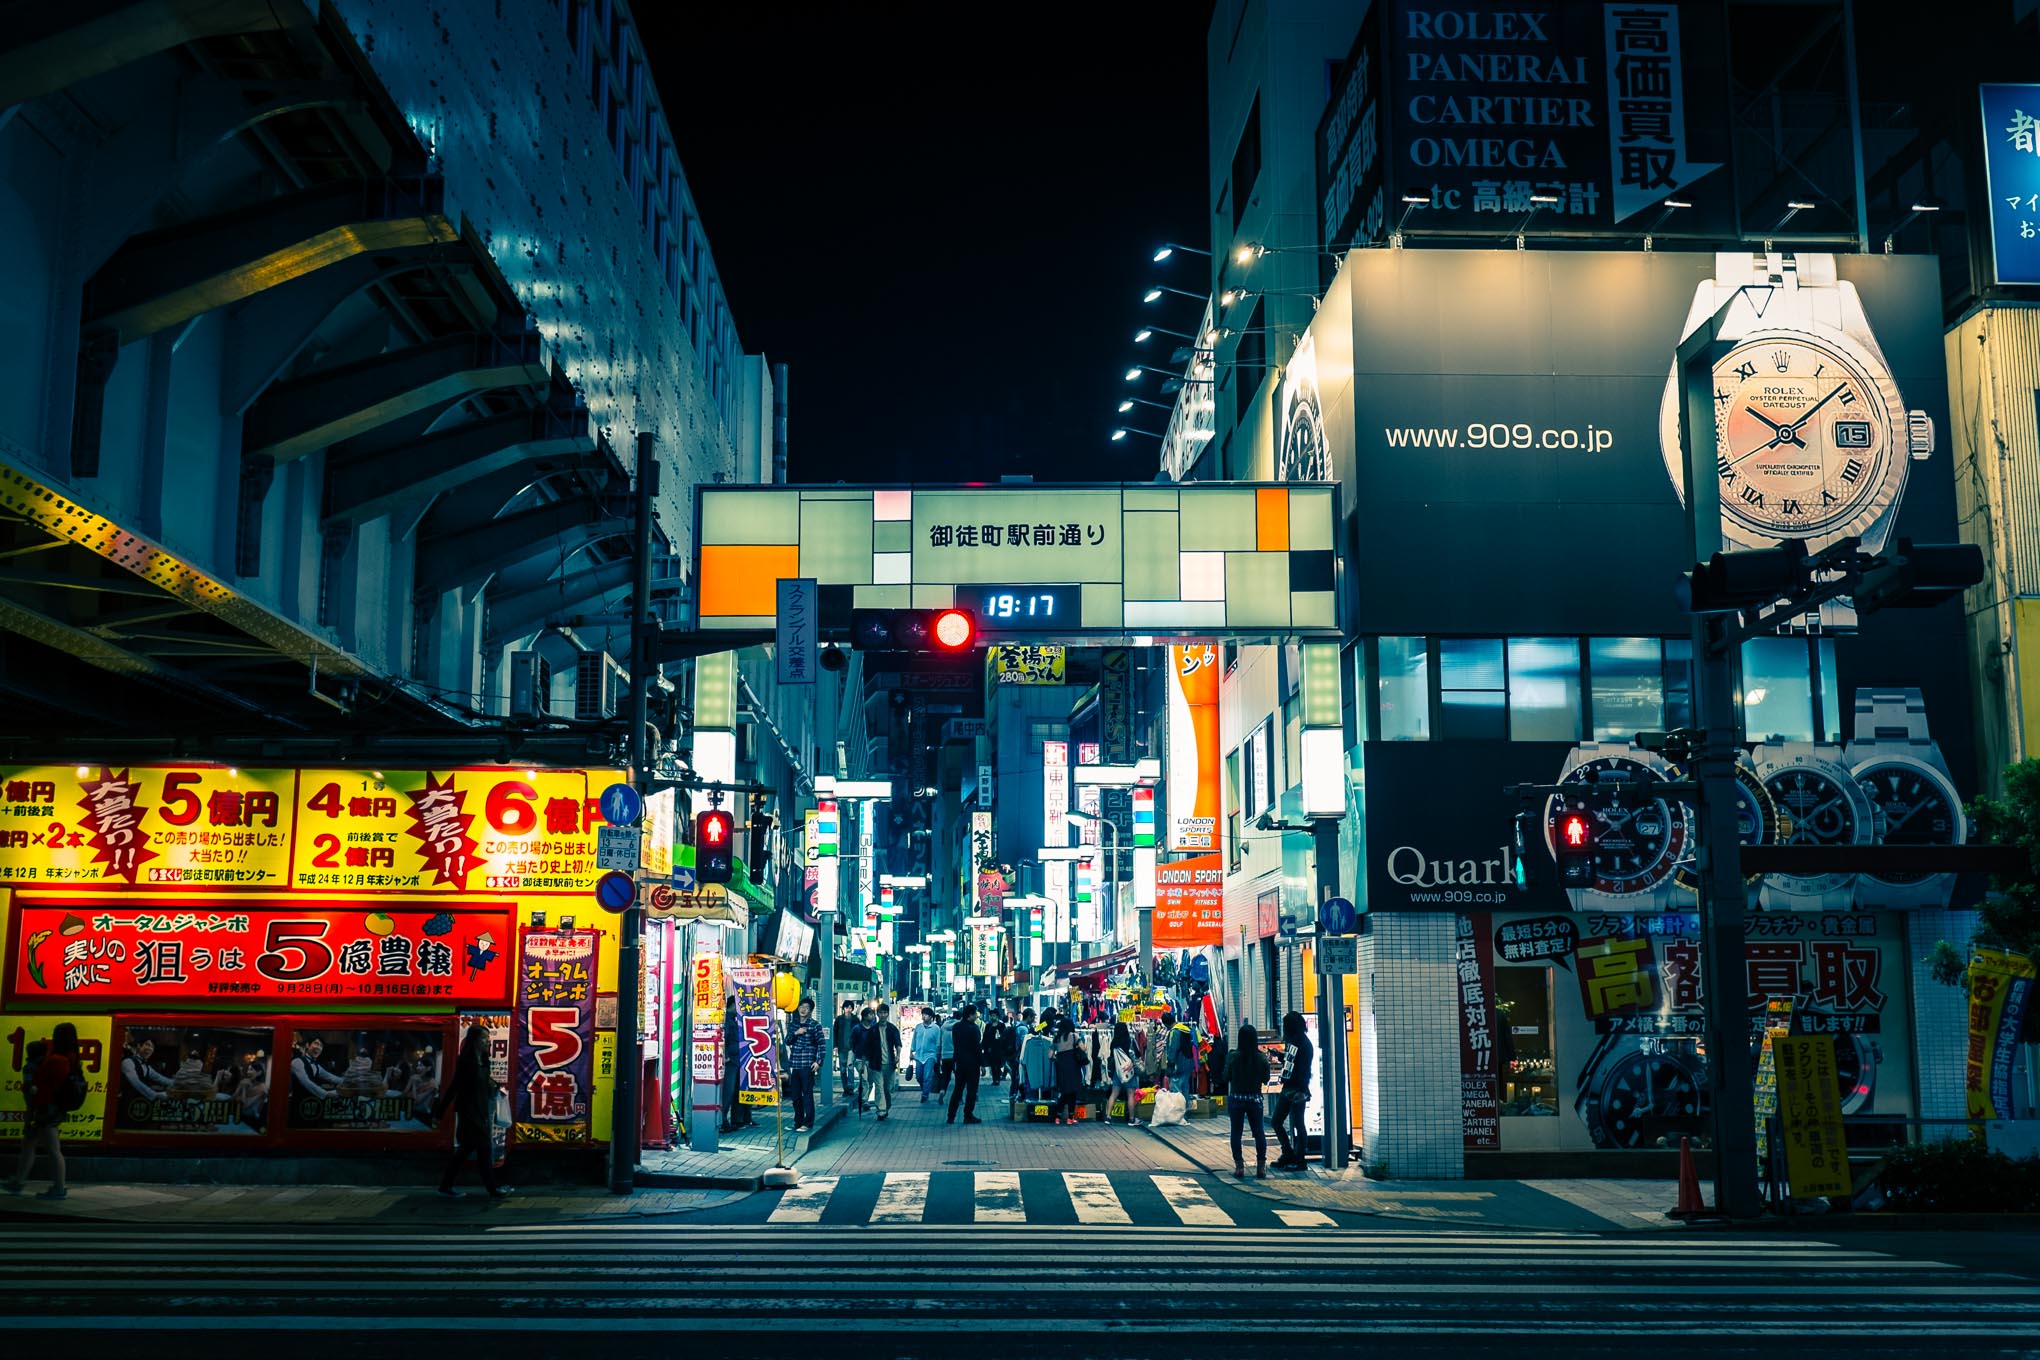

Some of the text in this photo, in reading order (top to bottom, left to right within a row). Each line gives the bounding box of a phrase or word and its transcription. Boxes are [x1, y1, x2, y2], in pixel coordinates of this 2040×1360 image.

[1407, 10, 1548, 41] ROLEX
[1407, 52, 1589, 85] PANERAI
[1611, 8, 1679, 191] 高価買取
[1408, 95, 1596, 128] CARTIER
[1410, 138, 1568, 169] OMEGA
[2006, 194, 2040, 212] マイ
[2020, 220, 2040, 239] お
[1763, 386, 1805, 396] ROLEX
[1778, 395, 1819, 403] PERPETUAL
[1385, 423, 1613, 453] www.909.co.jp
[1840, 427, 1867, 443] 15
[929, 524, 1107, 548] 御徒町駅前通り
[987, 594, 1055, 618] 19:17
[1000, 666, 1064, 683] 280円 うどん
[0, 774, 55, 803] 億円
[158, 771, 280, 828] 5億円
[307, 782, 397, 819] 4億円
[153, 831, 286, 847] この売り場から出ました!
[347, 832, 398, 843] 前後賞で
[600, 829, 636, 838] 自転車を除く
[1180, 826, 1213, 834] SPORTS
[1640, 825, 1658, 835] 27
[311, 833, 395, 868] 2億円
[484, 840, 597, 856] この売り場から出まし
[602, 839, 635, 849] 13 6
[601, 858, 634, 868] 12 6
[1387, 846, 1517, 888] Quark
[183, 869, 277, 881] 御徒町駅前センター
[1157, 869, 1224, 884] LONDON SPORT
[1410, 890, 1507, 904] www.909.co.jp
[92, 913, 250, 933] オータムジャンボ
[1590, 914, 1701, 936] ブランド時計・
[1501, 922, 1572, 943] 最短5分の
[64, 937, 127, 967] 実りの
[1503, 936, 1573, 960] 無料査定!
[64, 964, 112, 992] 秋に
[527, 961, 589, 981] オータム
[208, 982, 262, 994] 好評発売中
[526, 982, 588, 1001] ジャンボ
[696, 959, 711, 1007] 5億円
[737, 987, 770, 999] オータム
[738, 1001, 771, 1012] ジャンボ
[1608, 1016, 1704, 1034] アメ横一番の
[7, 1026, 103, 1073] 1円
[1461, 1081, 1487, 1089] ROLEX
[1462, 1109, 1476, 1117] WC
[1462, 1118, 1497, 1126] CARTIER
[1462, 1127, 1495, 1136] CHANEL
